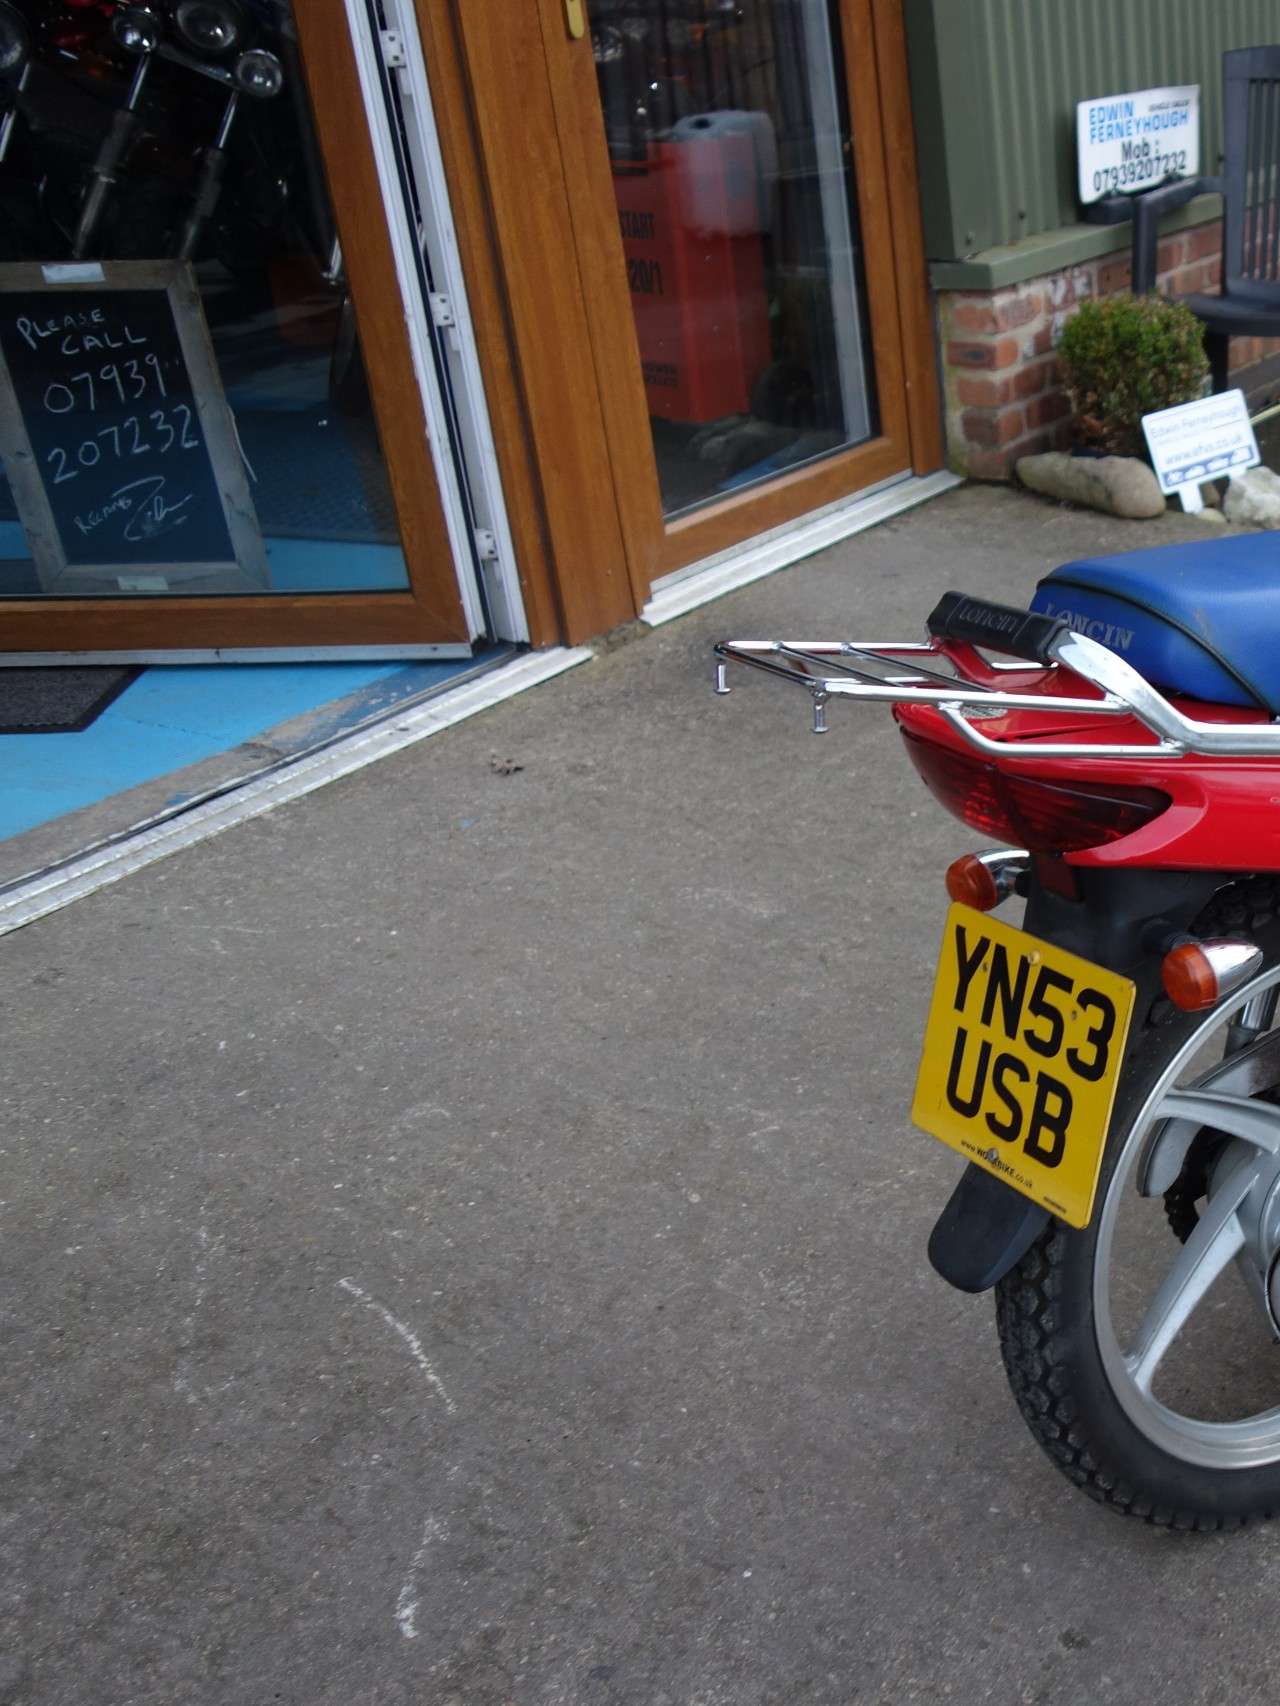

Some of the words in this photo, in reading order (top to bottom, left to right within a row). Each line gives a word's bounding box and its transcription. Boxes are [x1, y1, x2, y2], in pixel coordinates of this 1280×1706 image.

[1089, 100, 1134, 125] EDWIN
[1089, 111, 1189, 144] FERNEYHOUGH
[1093, 150, 1187, 192] 07939207232
[17, 308, 106, 351] PLEASE
[61, 327, 148, 355] CALL
[44, 354, 168, 413] 07939
[48, 404, 200, 484] 207232
[953, 924, 1117, 1082] YN53
[945, 1026, 1074, 1169] USB
